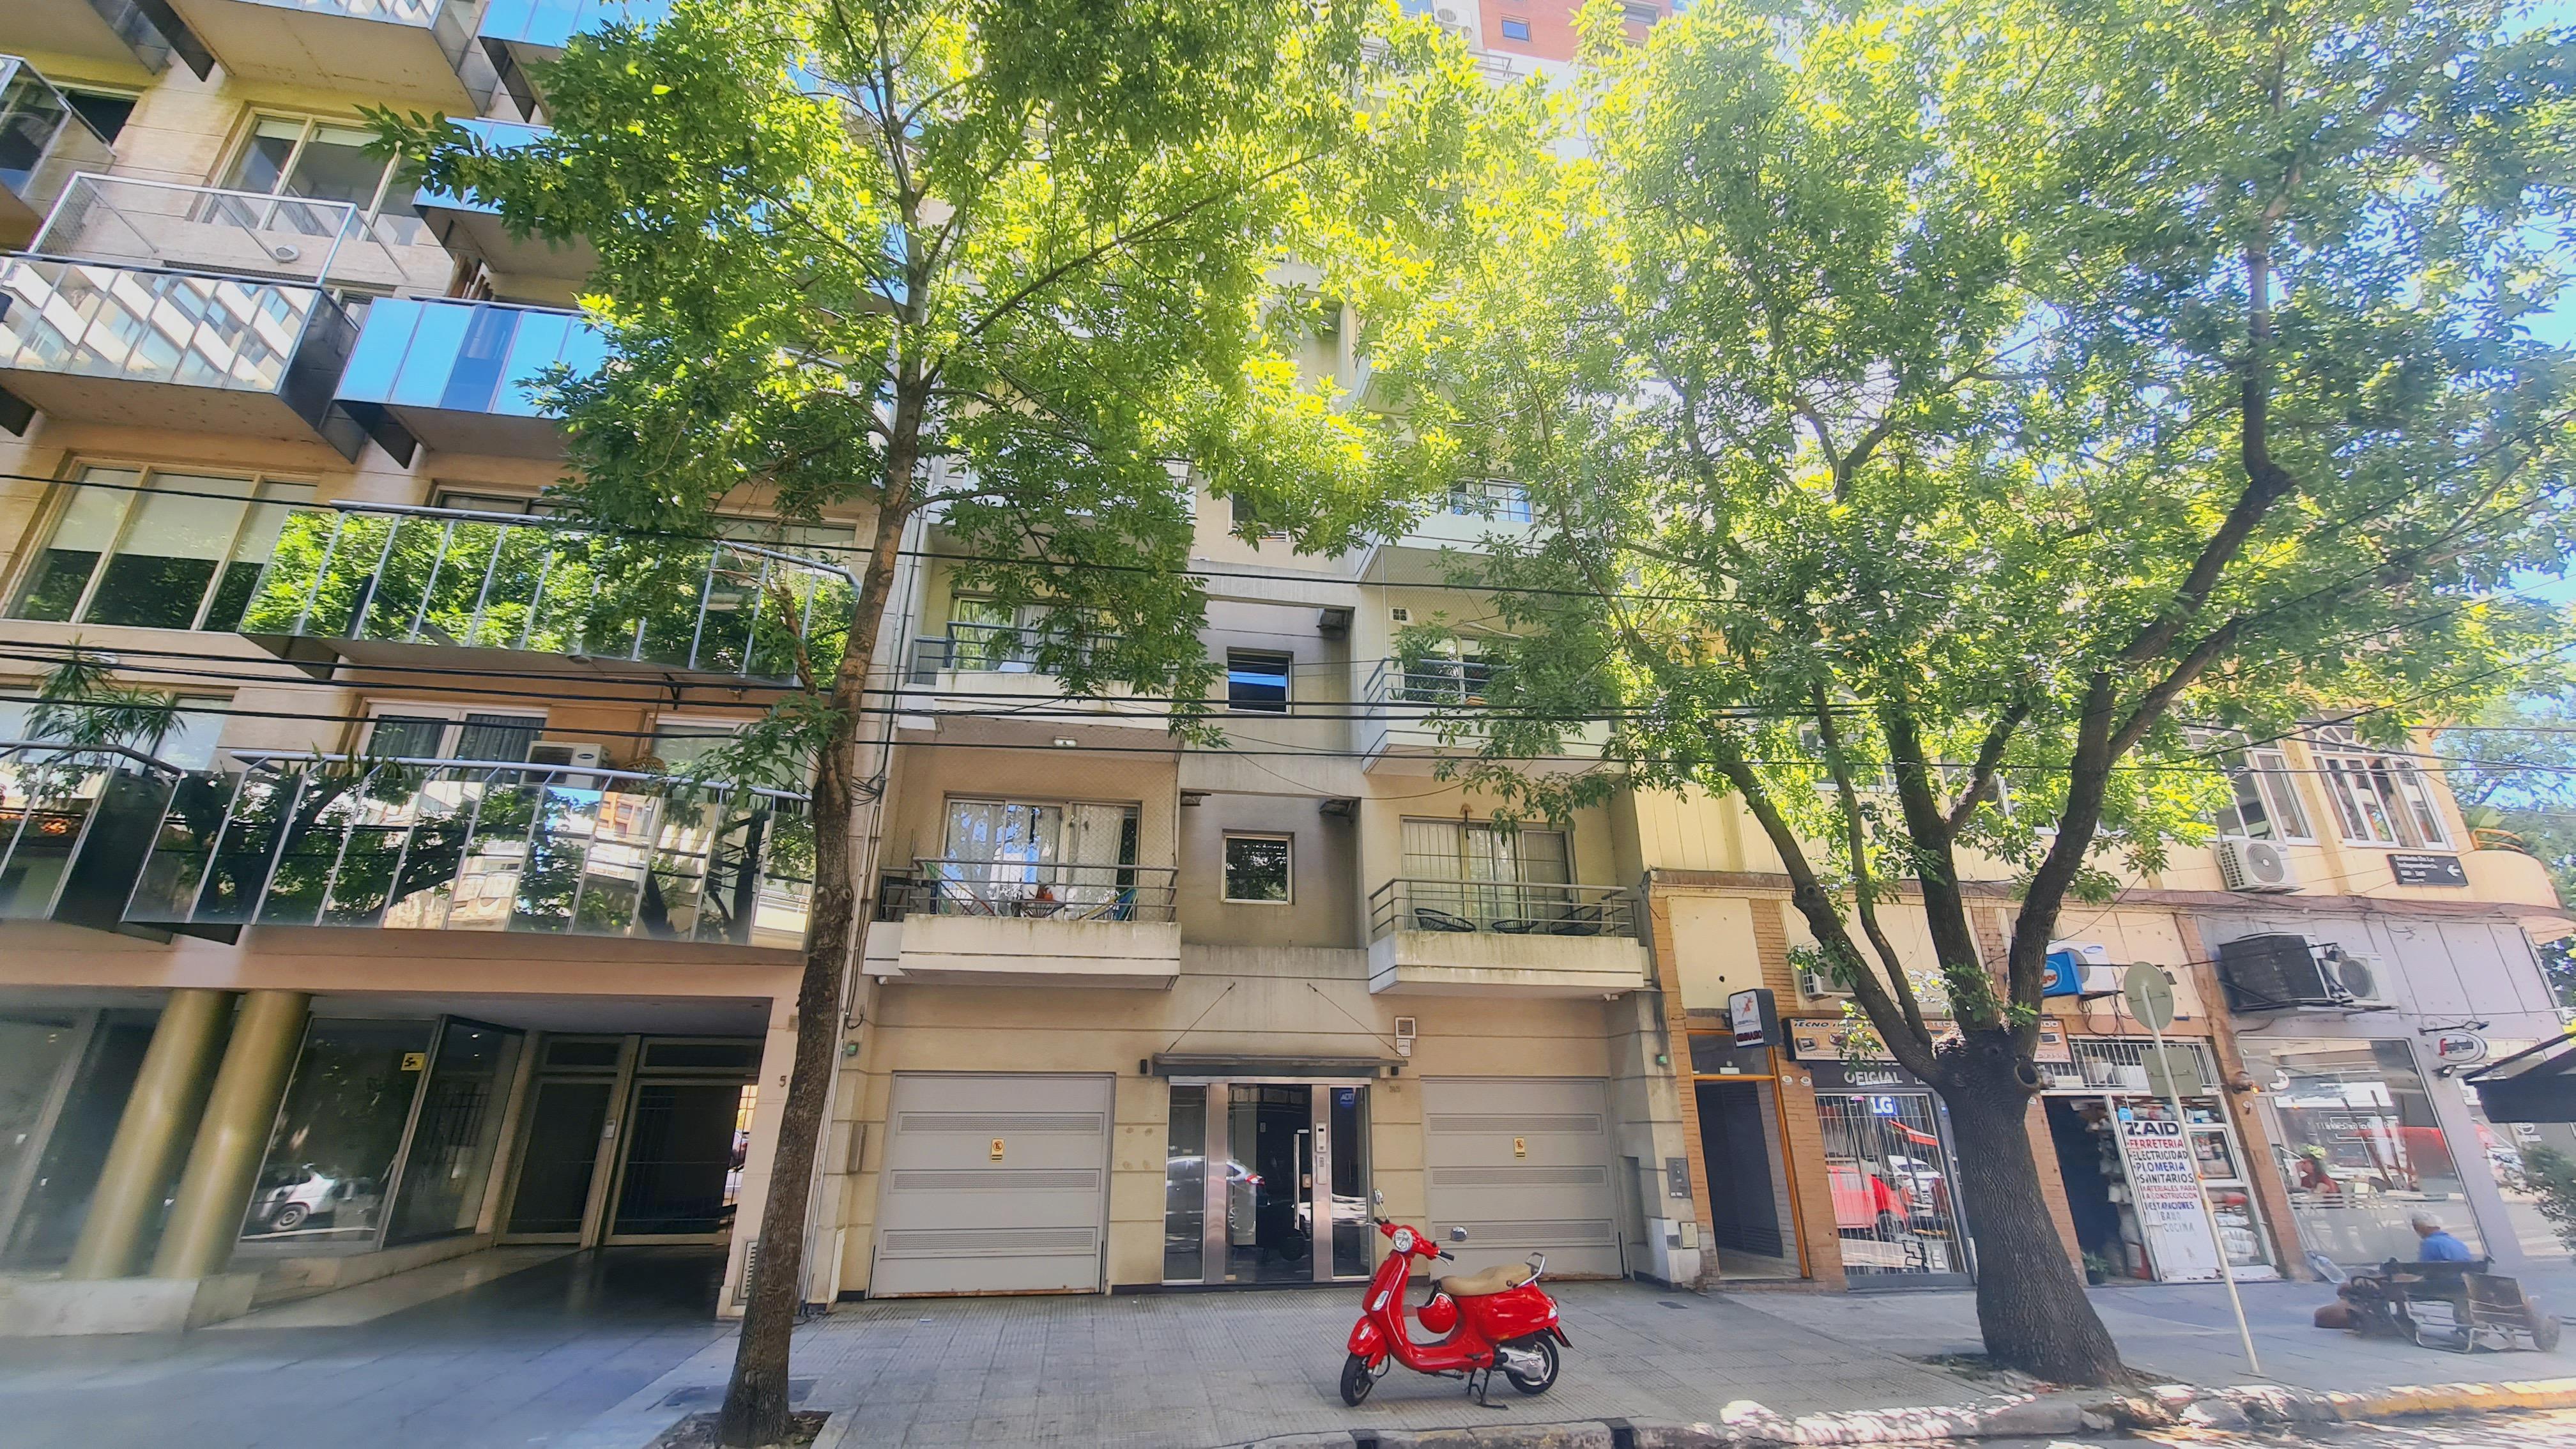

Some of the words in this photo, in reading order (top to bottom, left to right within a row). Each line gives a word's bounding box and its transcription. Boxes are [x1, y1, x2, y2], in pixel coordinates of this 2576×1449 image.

[1793, 1019, 1829, 1027] TECNO
[1870, 1096, 1894, 1114] LG
[2125, 1122, 2179, 1135] ZAID
[2133, 1151, 2188, 1161] ELECTRICIDAD
[2136, 1162, 2186, 1172] PLOMERIA
[2140, 1174, 2194, 1183] SANITARIOS
